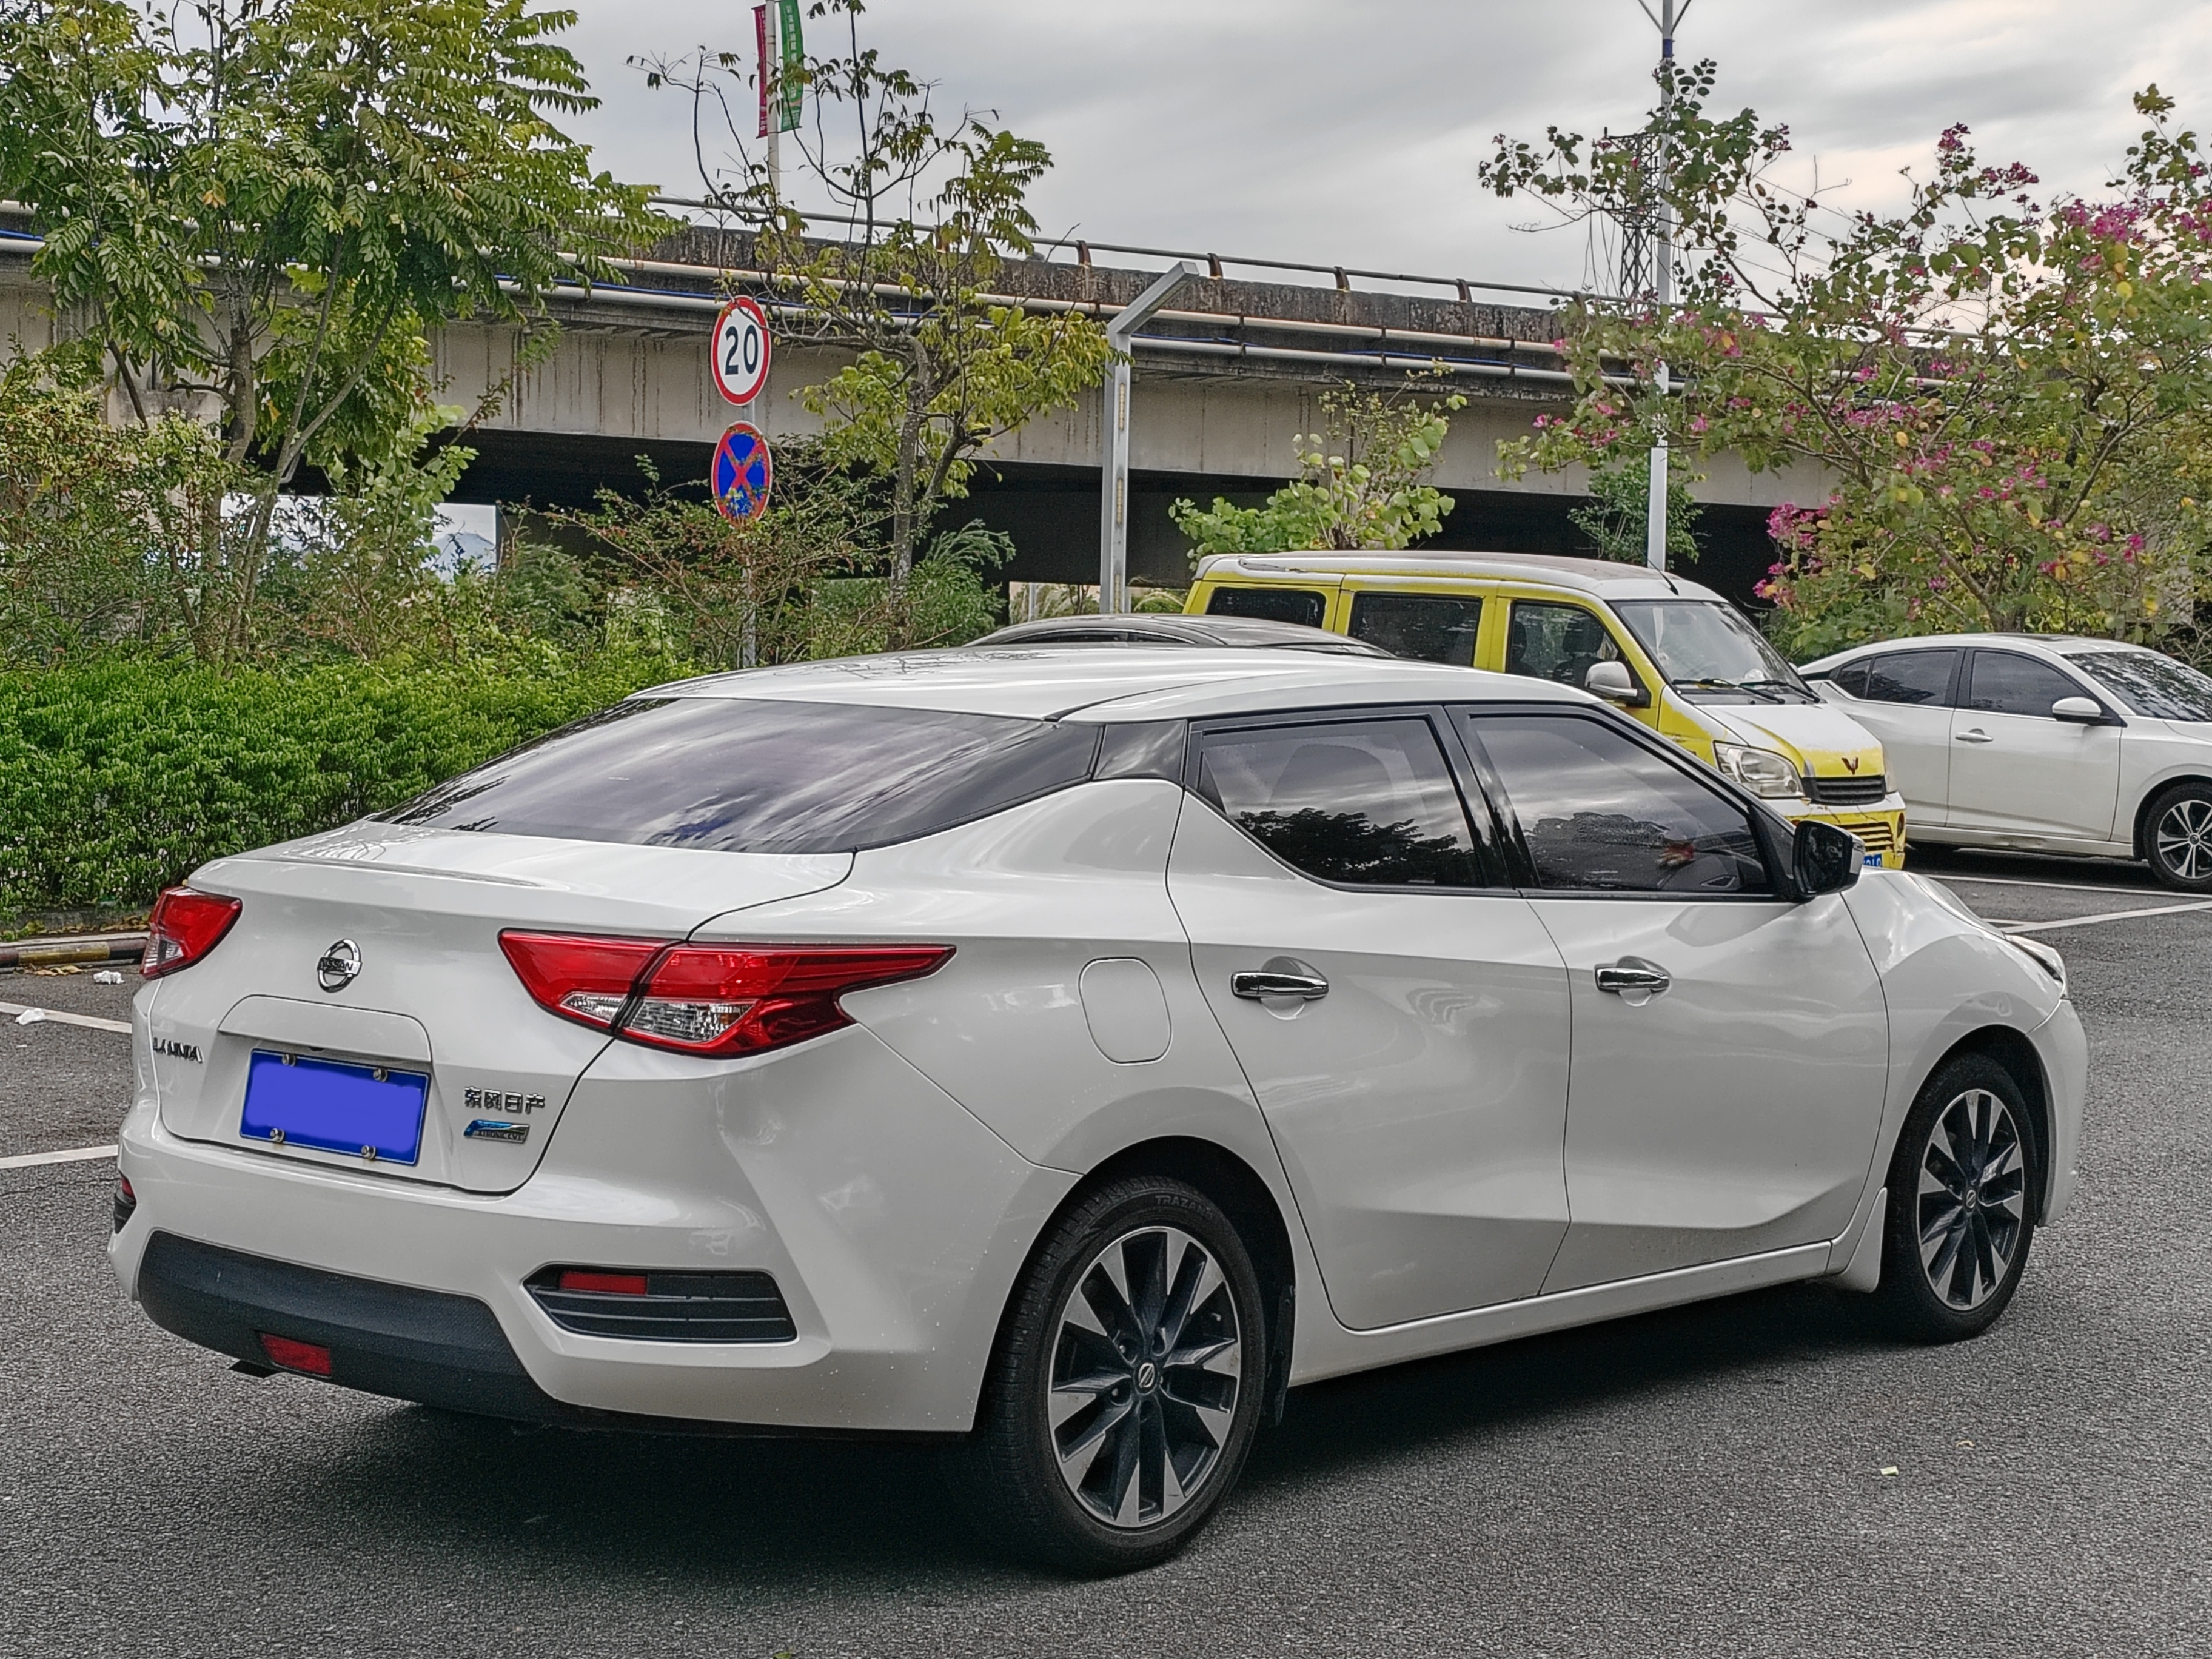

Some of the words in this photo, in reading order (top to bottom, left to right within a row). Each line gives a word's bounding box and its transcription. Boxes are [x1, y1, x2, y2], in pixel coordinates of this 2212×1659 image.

[725, 324, 759, 375] 20
[464, 1086, 546, 1115] 东风日产
